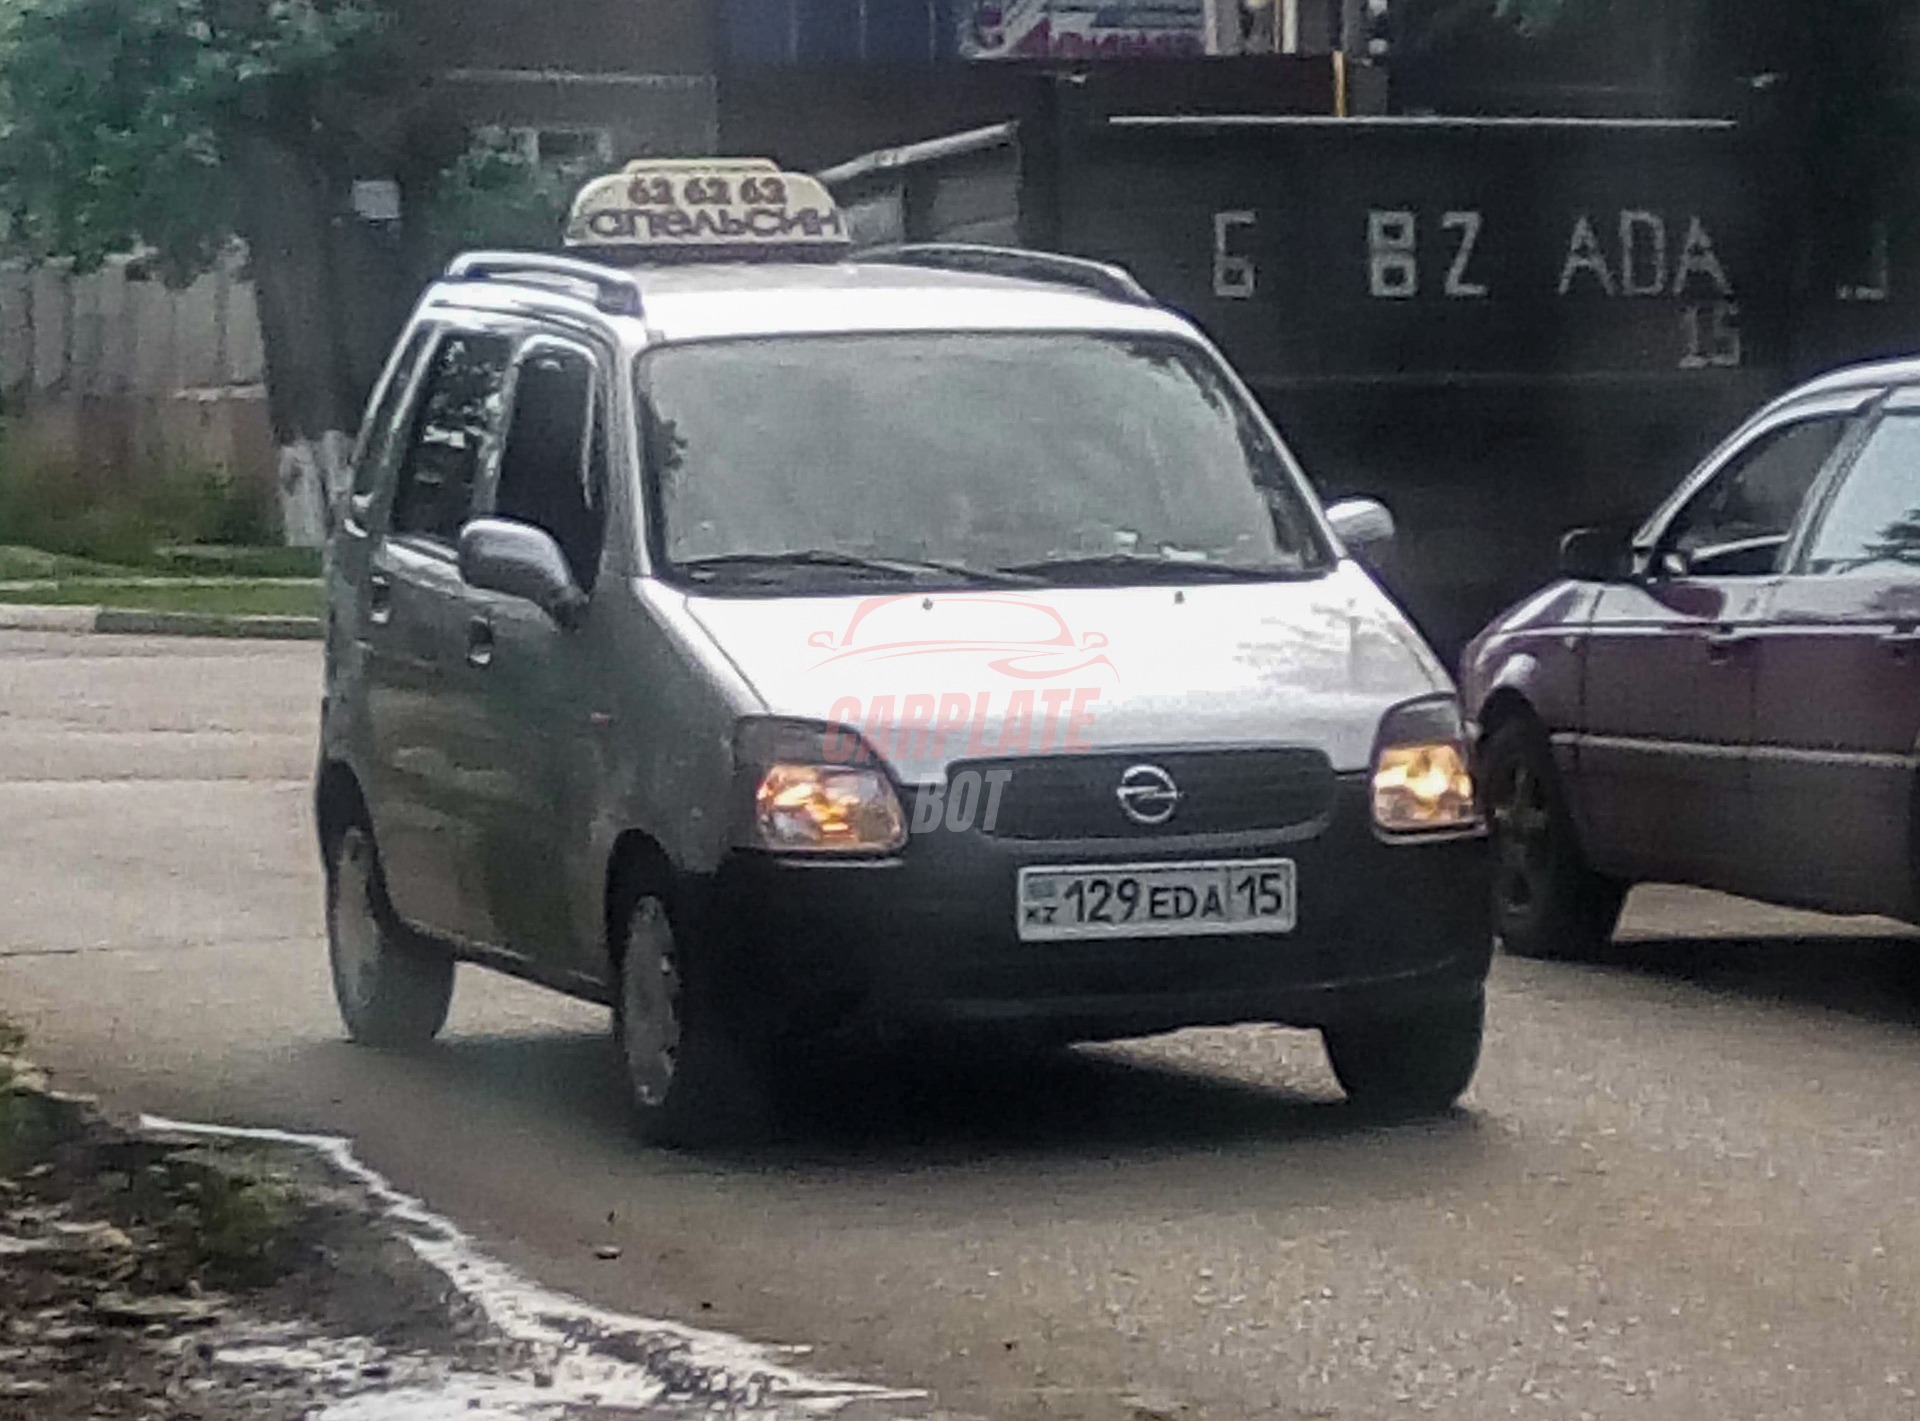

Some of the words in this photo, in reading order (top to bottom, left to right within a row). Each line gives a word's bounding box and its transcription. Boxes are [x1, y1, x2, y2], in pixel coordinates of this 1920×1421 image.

[684, 177, 732, 205] 62
[1557, 207, 1735, 298] ADA
[1236, 872, 1282, 916] 15
